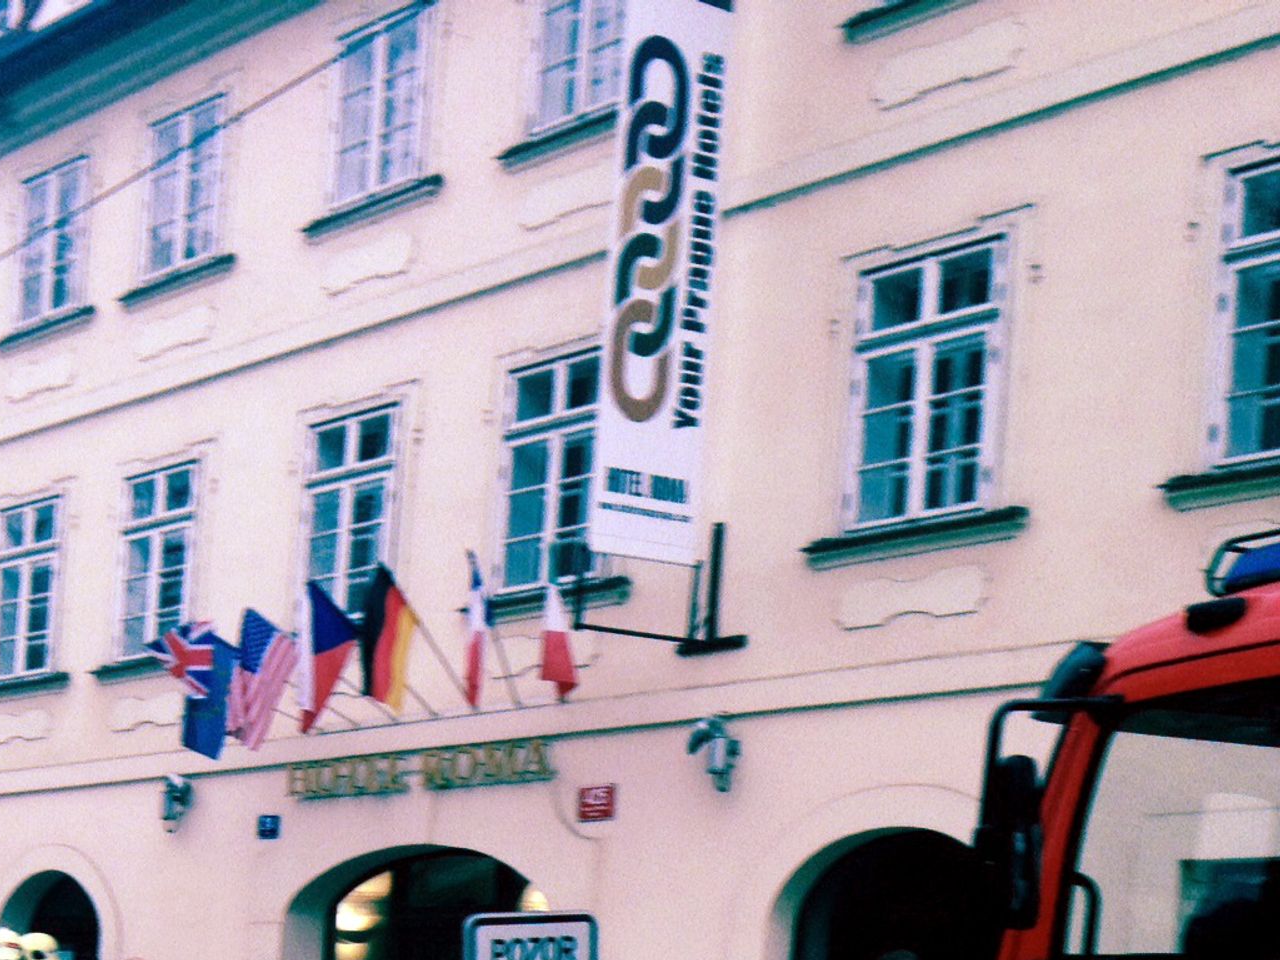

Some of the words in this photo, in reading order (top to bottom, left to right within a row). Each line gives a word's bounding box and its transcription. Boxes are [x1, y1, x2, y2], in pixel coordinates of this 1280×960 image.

[690, 53, 726, 182] Hotels
[681, 190, 715, 334] Prague
[672, 341, 705, 430] Your
